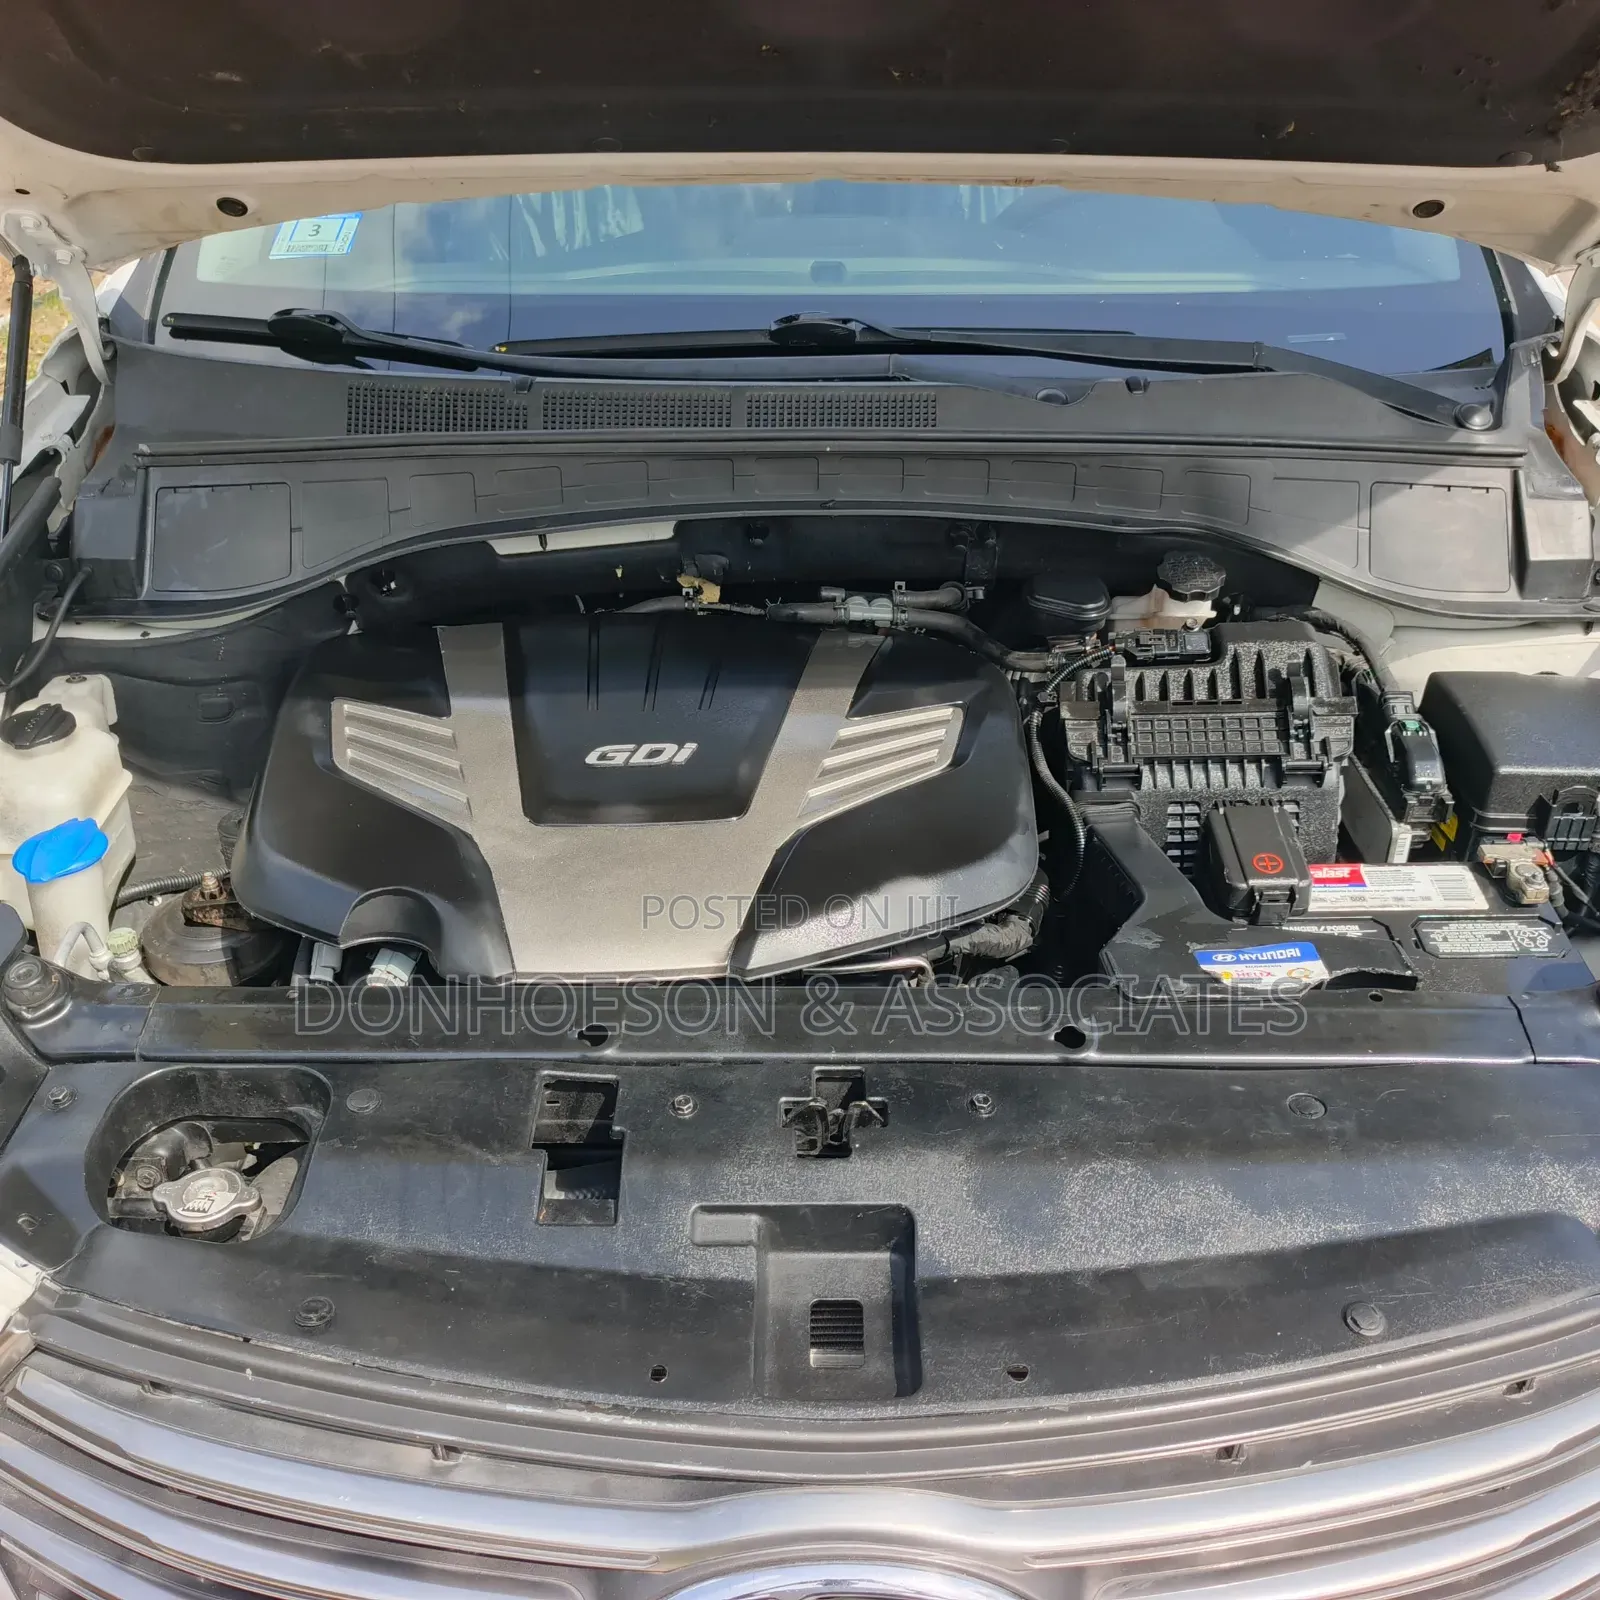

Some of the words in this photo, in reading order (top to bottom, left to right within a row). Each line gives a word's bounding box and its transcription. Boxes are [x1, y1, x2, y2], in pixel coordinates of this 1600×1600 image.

[308, 224, 321, 237] 3
[584, 742, 699, 767] GDi
[1238, 947, 1302, 961] HYUNDAI
